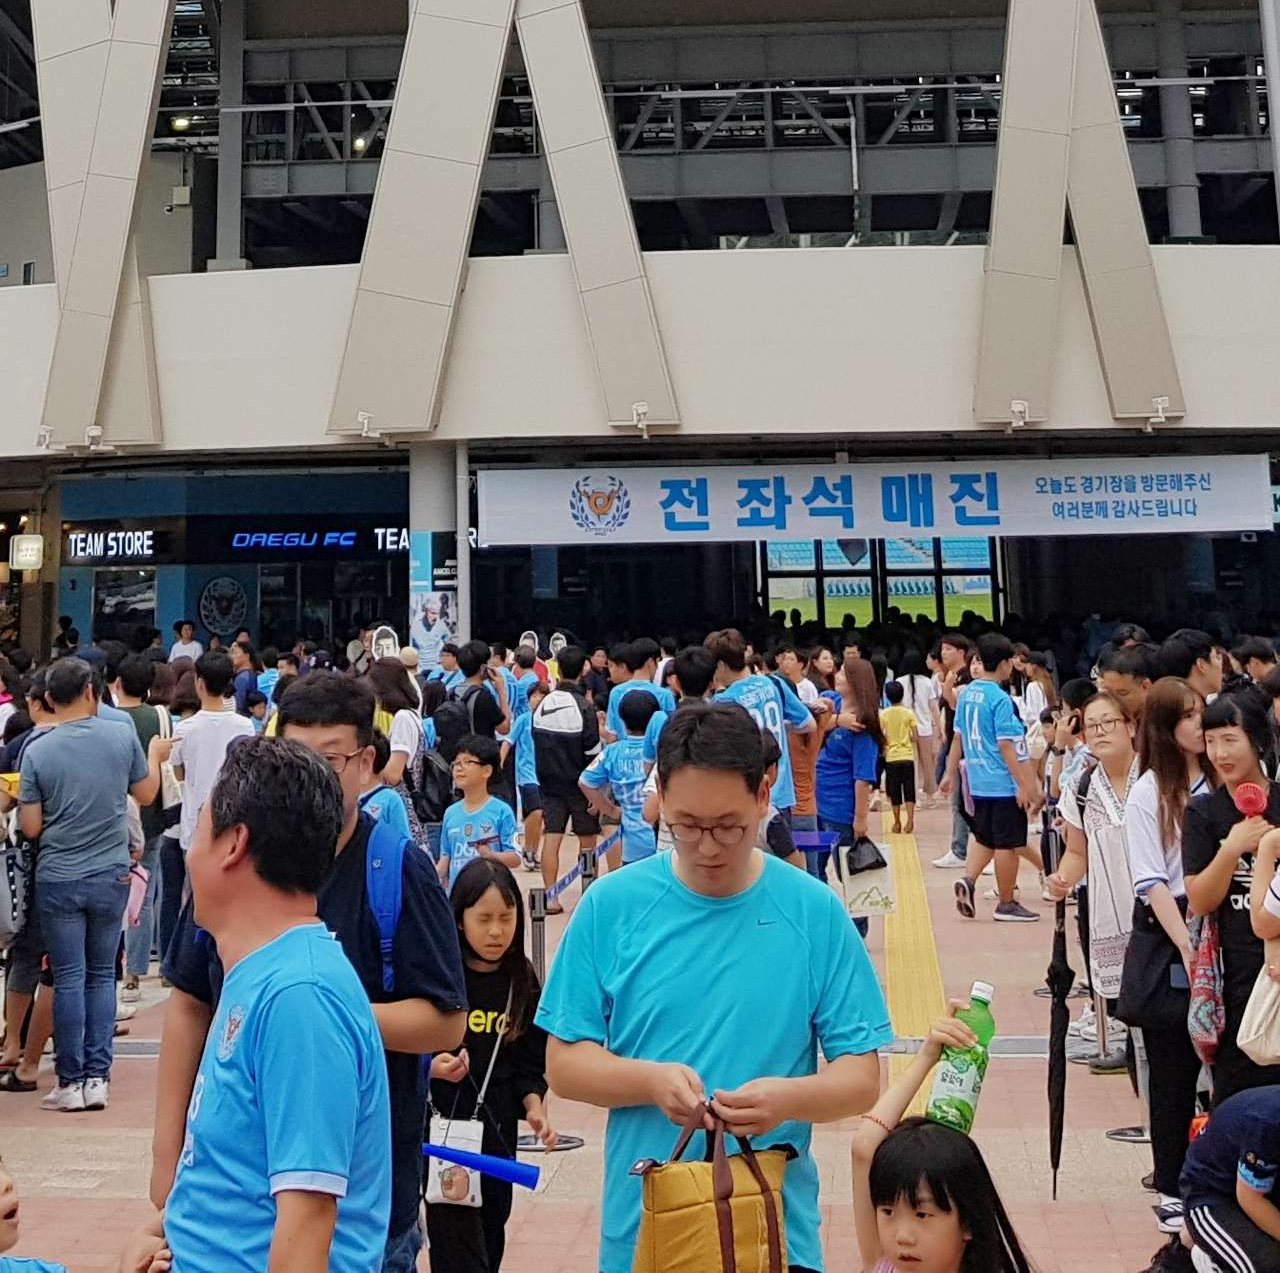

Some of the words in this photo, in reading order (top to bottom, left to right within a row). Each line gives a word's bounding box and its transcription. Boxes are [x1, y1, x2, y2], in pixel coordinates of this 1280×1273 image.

[1035, 476, 1077, 495] 오늘도
[1080, 475, 1137, 494] 경기장을
[1141, 472, 1212, 493] 방문해주신
[881, 471, 1001, 528] 매진
[1052, 500, 1108, 520] 여러분께
[1111, 498, 1198, 519] 감사드립니다
[69, 532, 104, 557] TEAM
[107, 530, 153, 556] STORE
[232, 532, 317, 548] DAEGU
[323, 531, 358, 547] FC
[374, 527, 409, 551] TEA
